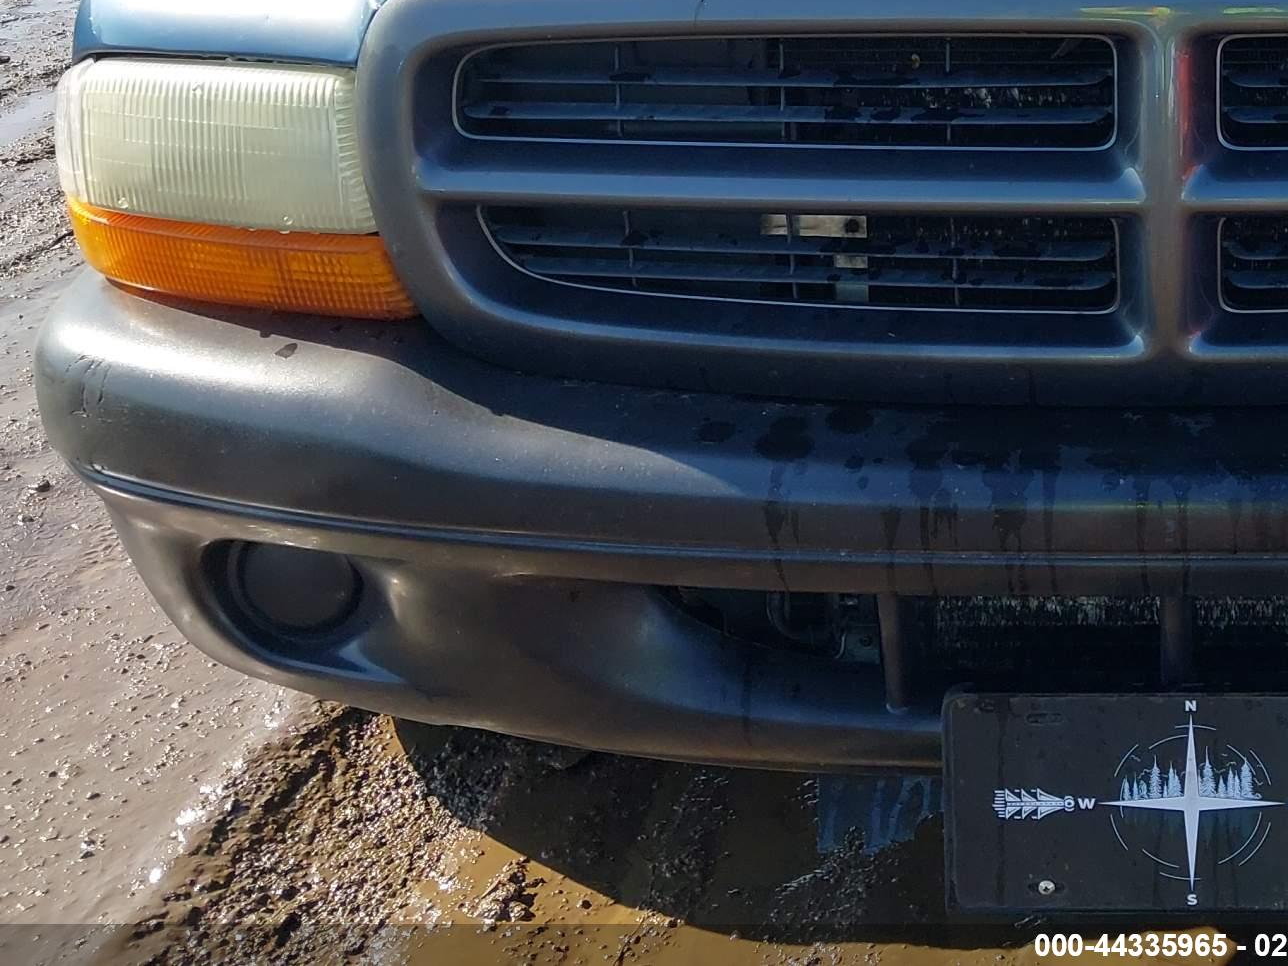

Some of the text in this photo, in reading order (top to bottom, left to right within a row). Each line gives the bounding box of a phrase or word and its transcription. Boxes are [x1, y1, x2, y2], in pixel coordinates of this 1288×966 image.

[1184, 700, 1198, 713] N
[1078, 797, 1097, 811] W
[1186, 893, 1199, 907] S
